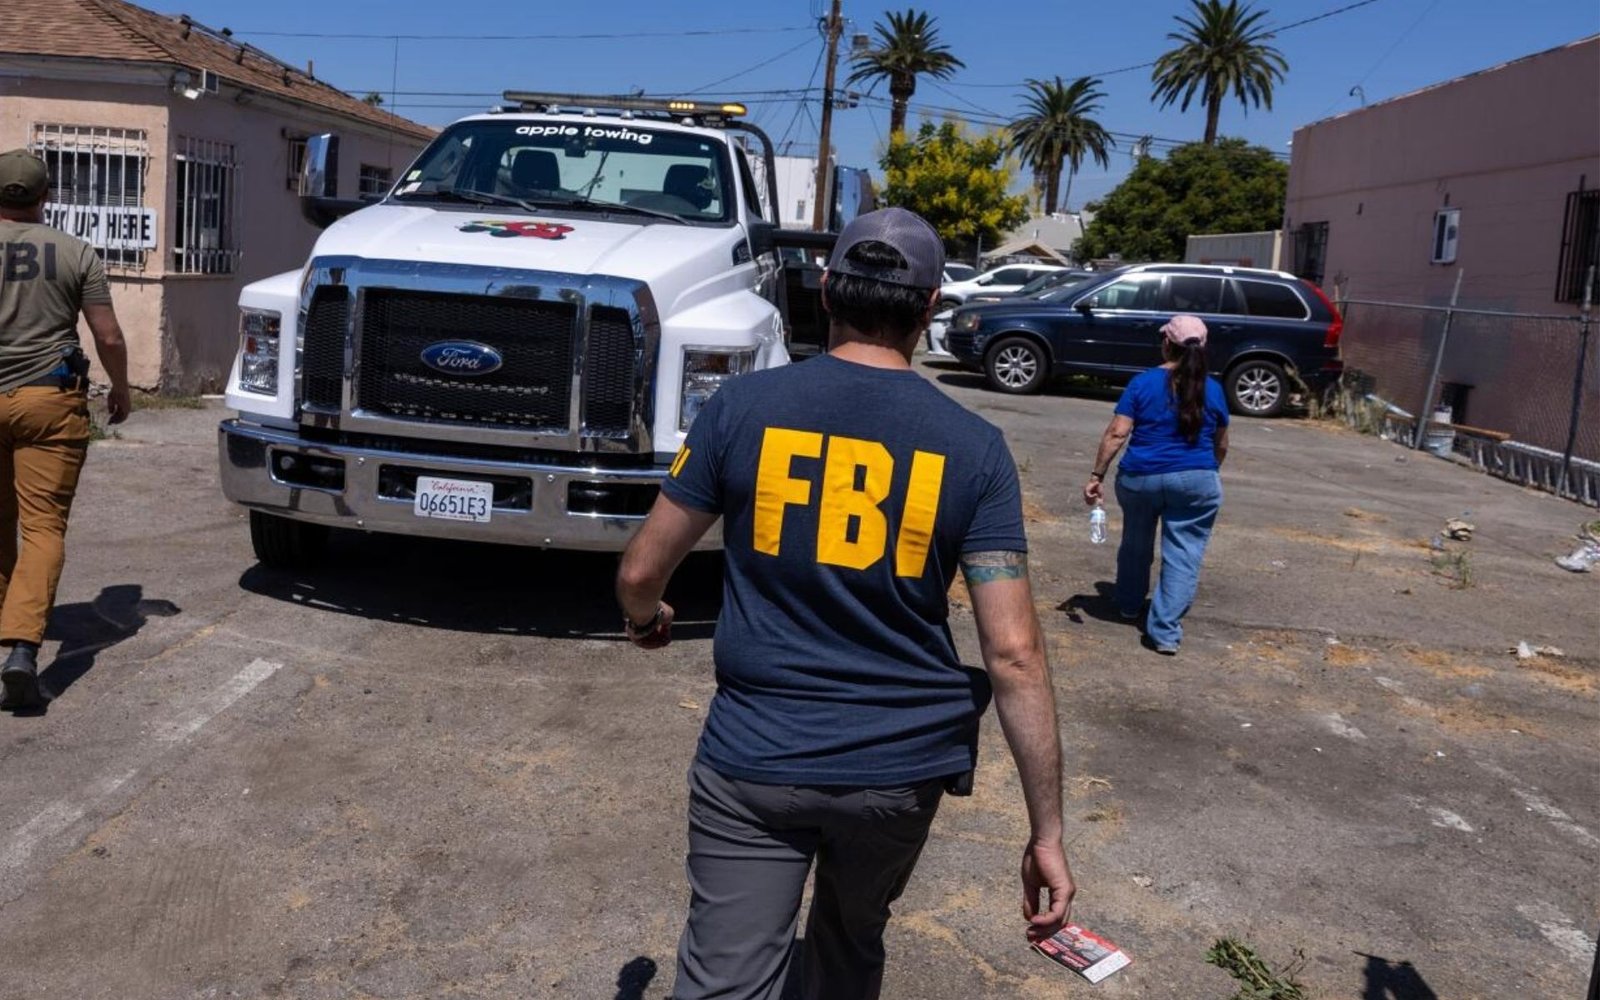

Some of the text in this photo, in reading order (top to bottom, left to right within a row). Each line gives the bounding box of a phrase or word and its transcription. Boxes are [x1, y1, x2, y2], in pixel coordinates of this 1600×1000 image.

[515, 125, 653, 145] apple towing
[75, 211, 99, 238] UP
[107, 212, 150, 240] HERE
[0, 242, 57, 281] BI
[437, 347, 482, 369] Ford
[420, 492, 487, 516] 06651E3
[753, 427, 946, 578] FBI
